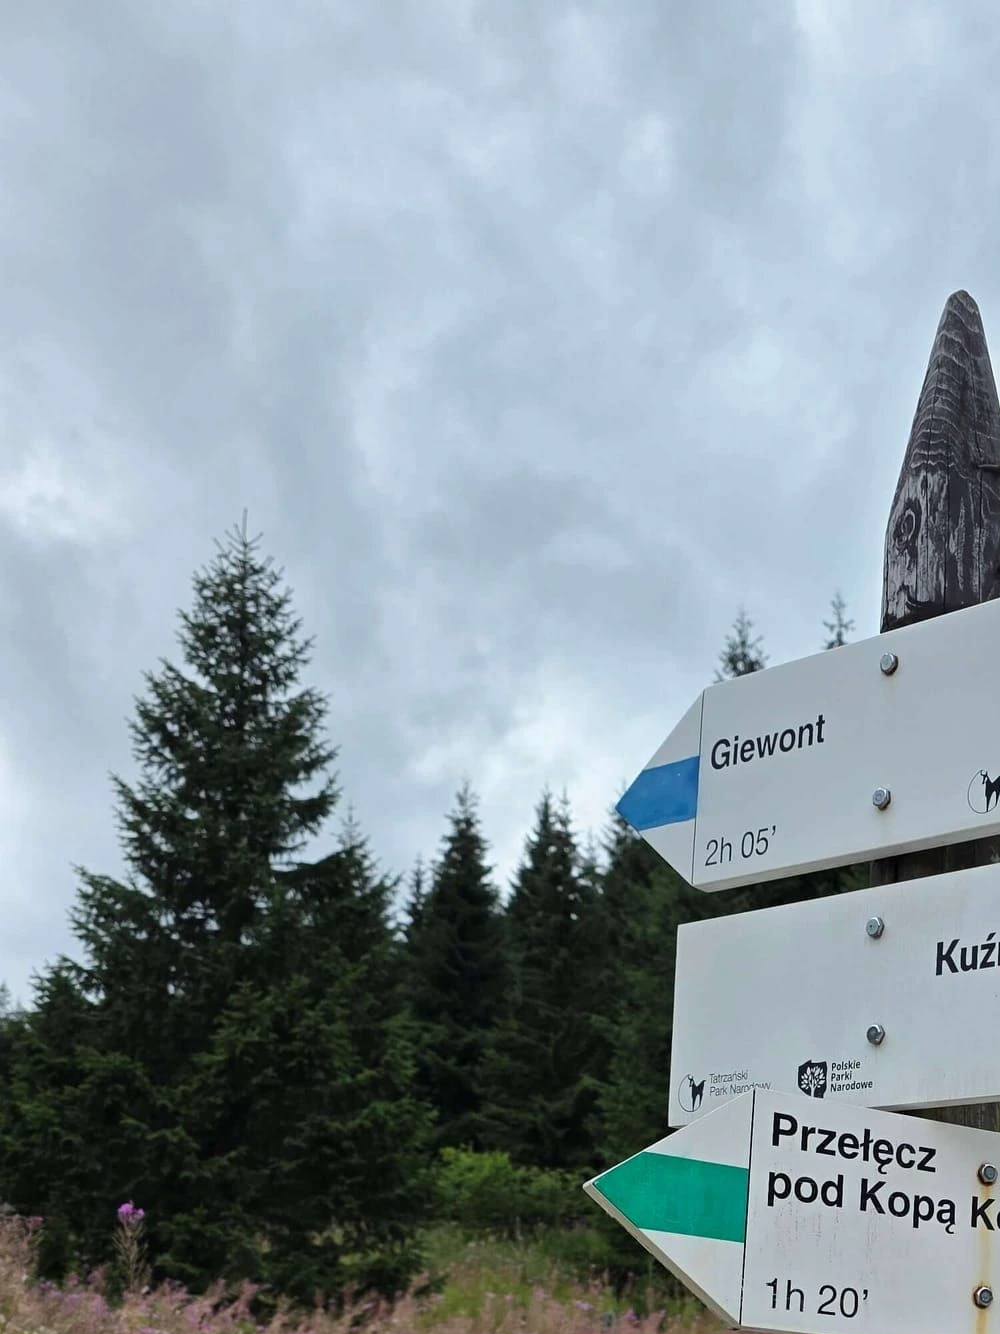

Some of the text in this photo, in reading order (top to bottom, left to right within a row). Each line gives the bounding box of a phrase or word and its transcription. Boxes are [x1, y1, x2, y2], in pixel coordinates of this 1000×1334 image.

[710, 714, 826, 770] Giewont
[704, 839, 733, 867] 2h
[708, 1070, 748, 1084] Tatrzański
[830, 1070, 853, 1084] Parki
[831, 1060, 862, 1073] Polskie
[708, 1084, 728, 1096] Park
[830, 1079, 874, 1092] Narodowe
[771, 1112, 938, 1174] Przełęcz
[767, 1171, 845, 1209] pod
[859, 1178, 956, 1234] Kopą
[765, 1277, 805, 1312] 1h
